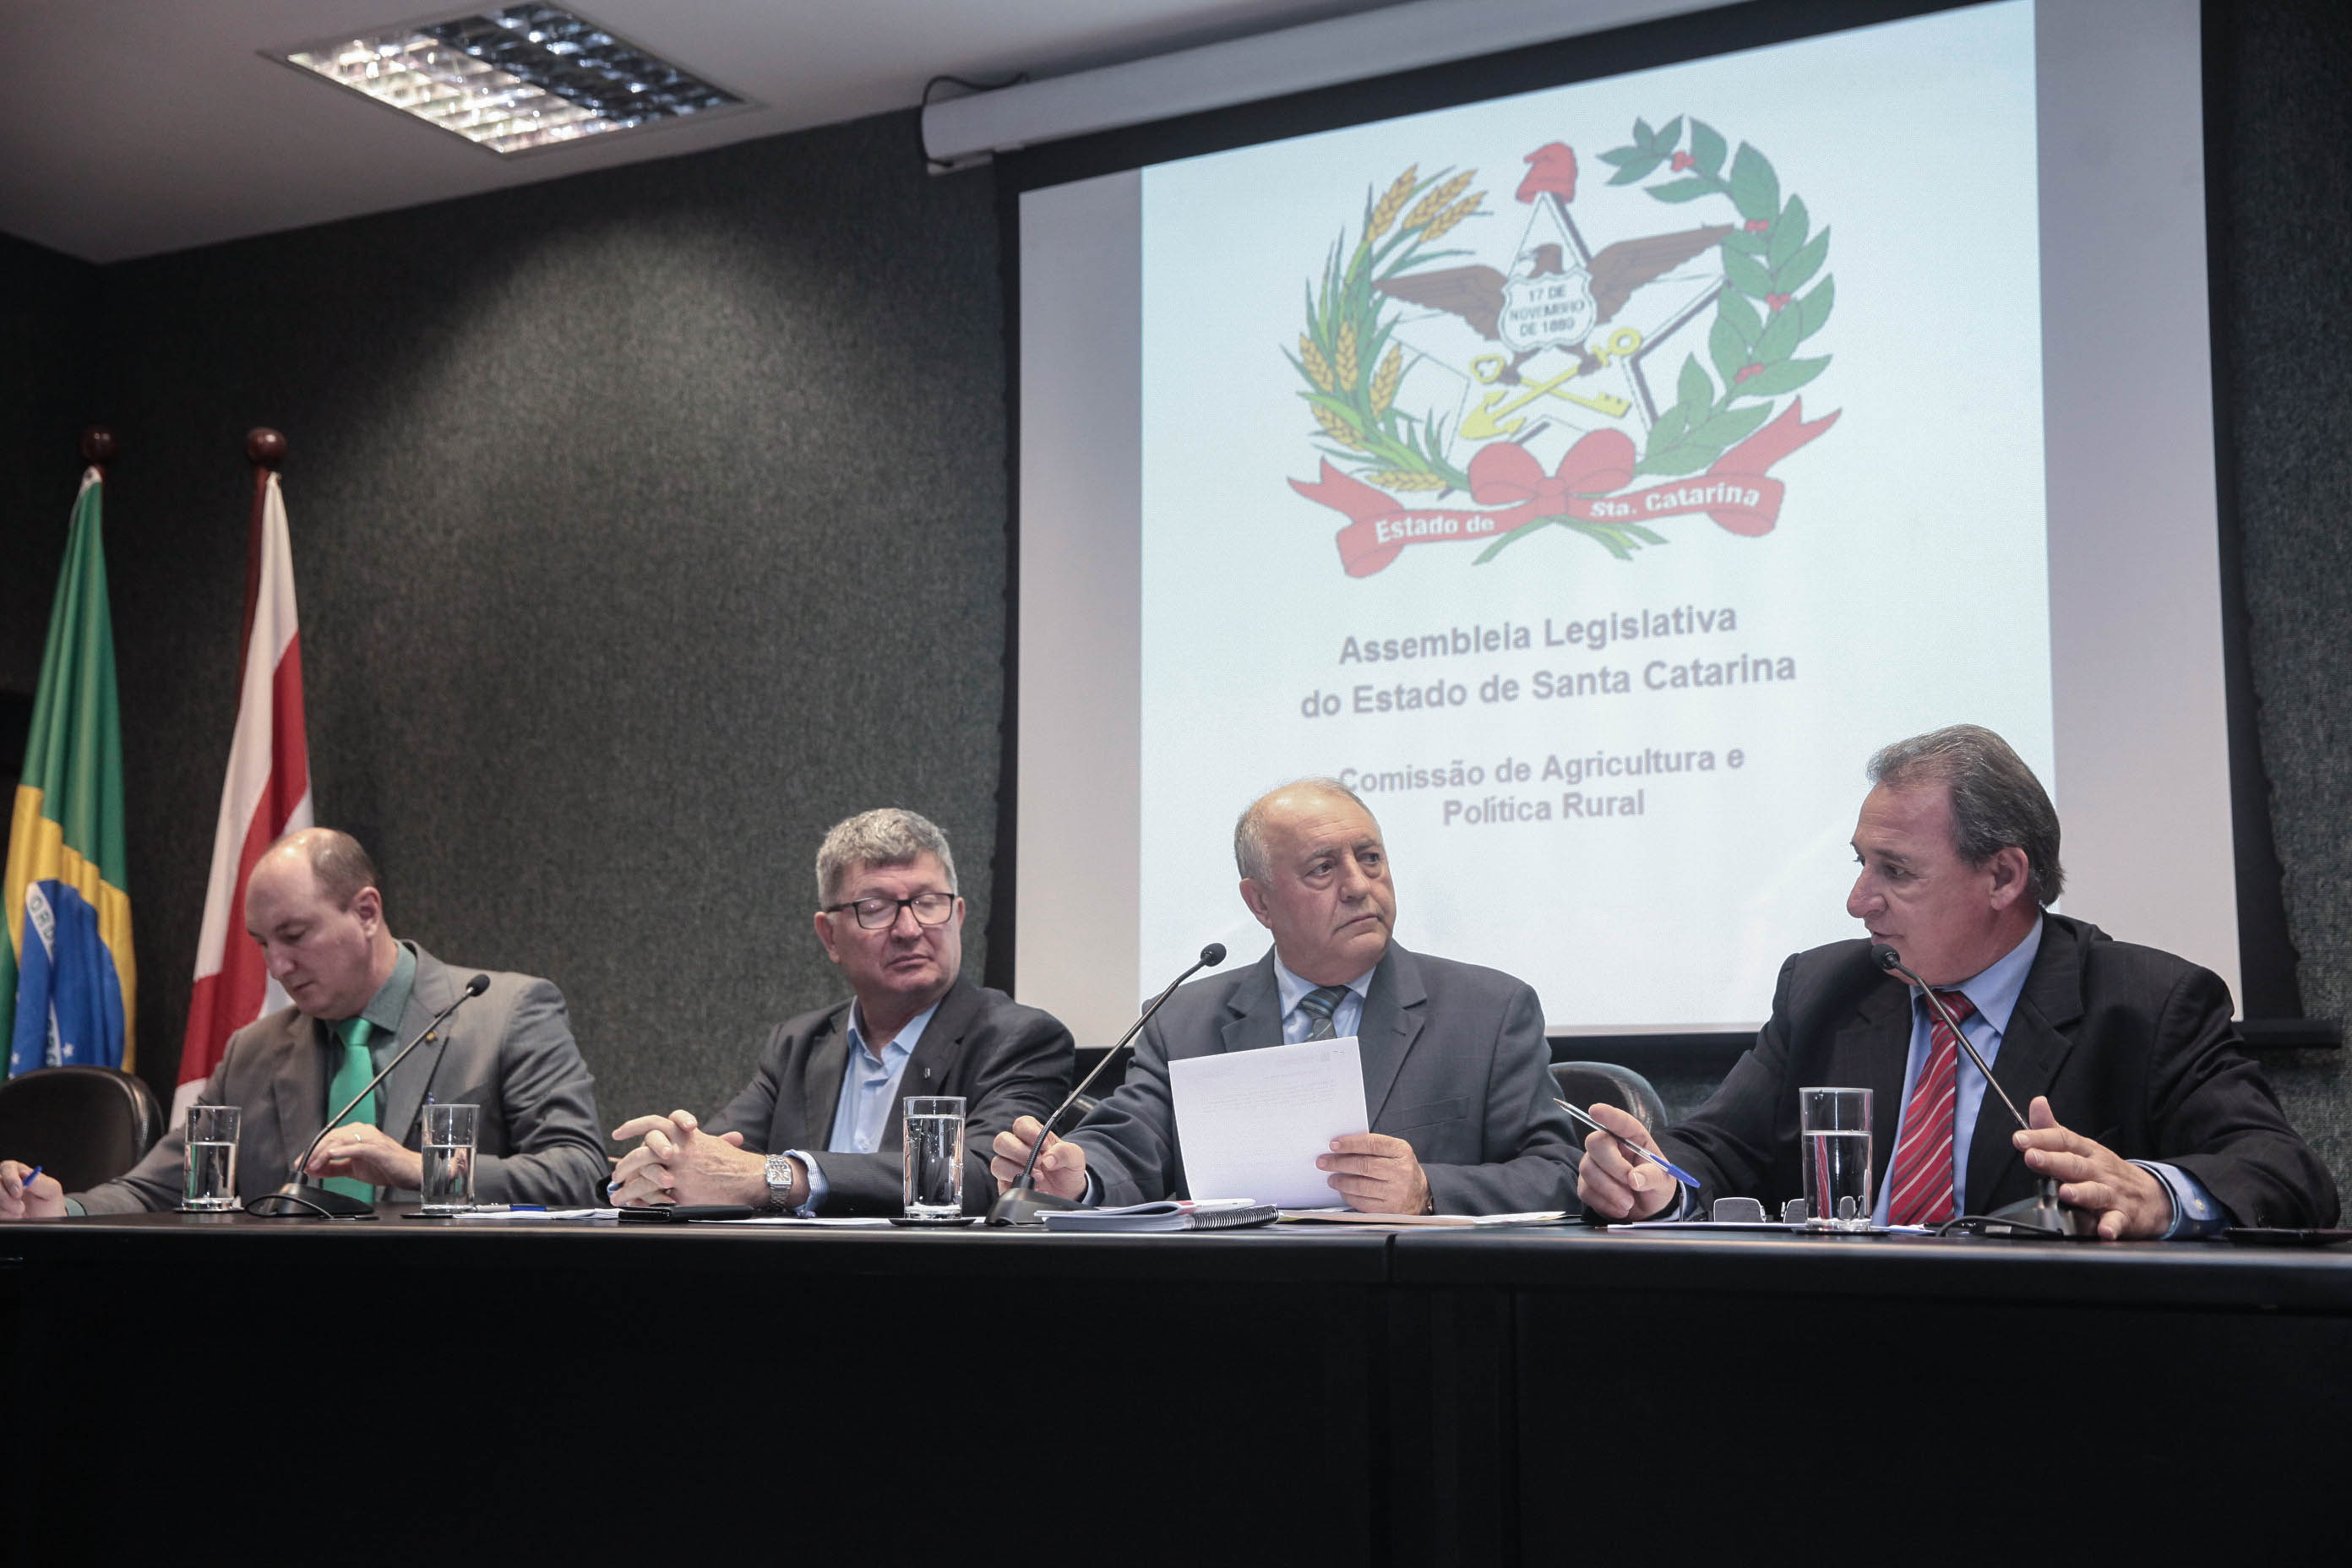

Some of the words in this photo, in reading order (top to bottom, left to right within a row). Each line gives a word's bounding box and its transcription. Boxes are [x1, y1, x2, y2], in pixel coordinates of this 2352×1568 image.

[1589, 500, 1638, 518] Sta.
[1645, 481, 1761, 513] Catarina
[1375, 514, 1459, 544] Estado
[1465, 514, 1495, 534] de
[1339, 622, 1532, 666] Assembleia
[1544, 605, 1738, 651] Legislativa
[1301, 689, 1342, 719] do
[1353, 679, 1468, 715] Estado
[1479, 674, 1521, 704] de
[1532, 667, 1631, 701] Santa
[1642, 653, 1797, 697] Catarina
[1340, 759, 1486, 794] Comissão
[1494, 756, 1532, 784] de
[1541, 748, 1717, 786] Agricultura
[1725, 748, 1745, 770] e
[1443, 795, 1553, 827] Política
[1563, 789, 1645, 820] Rural
